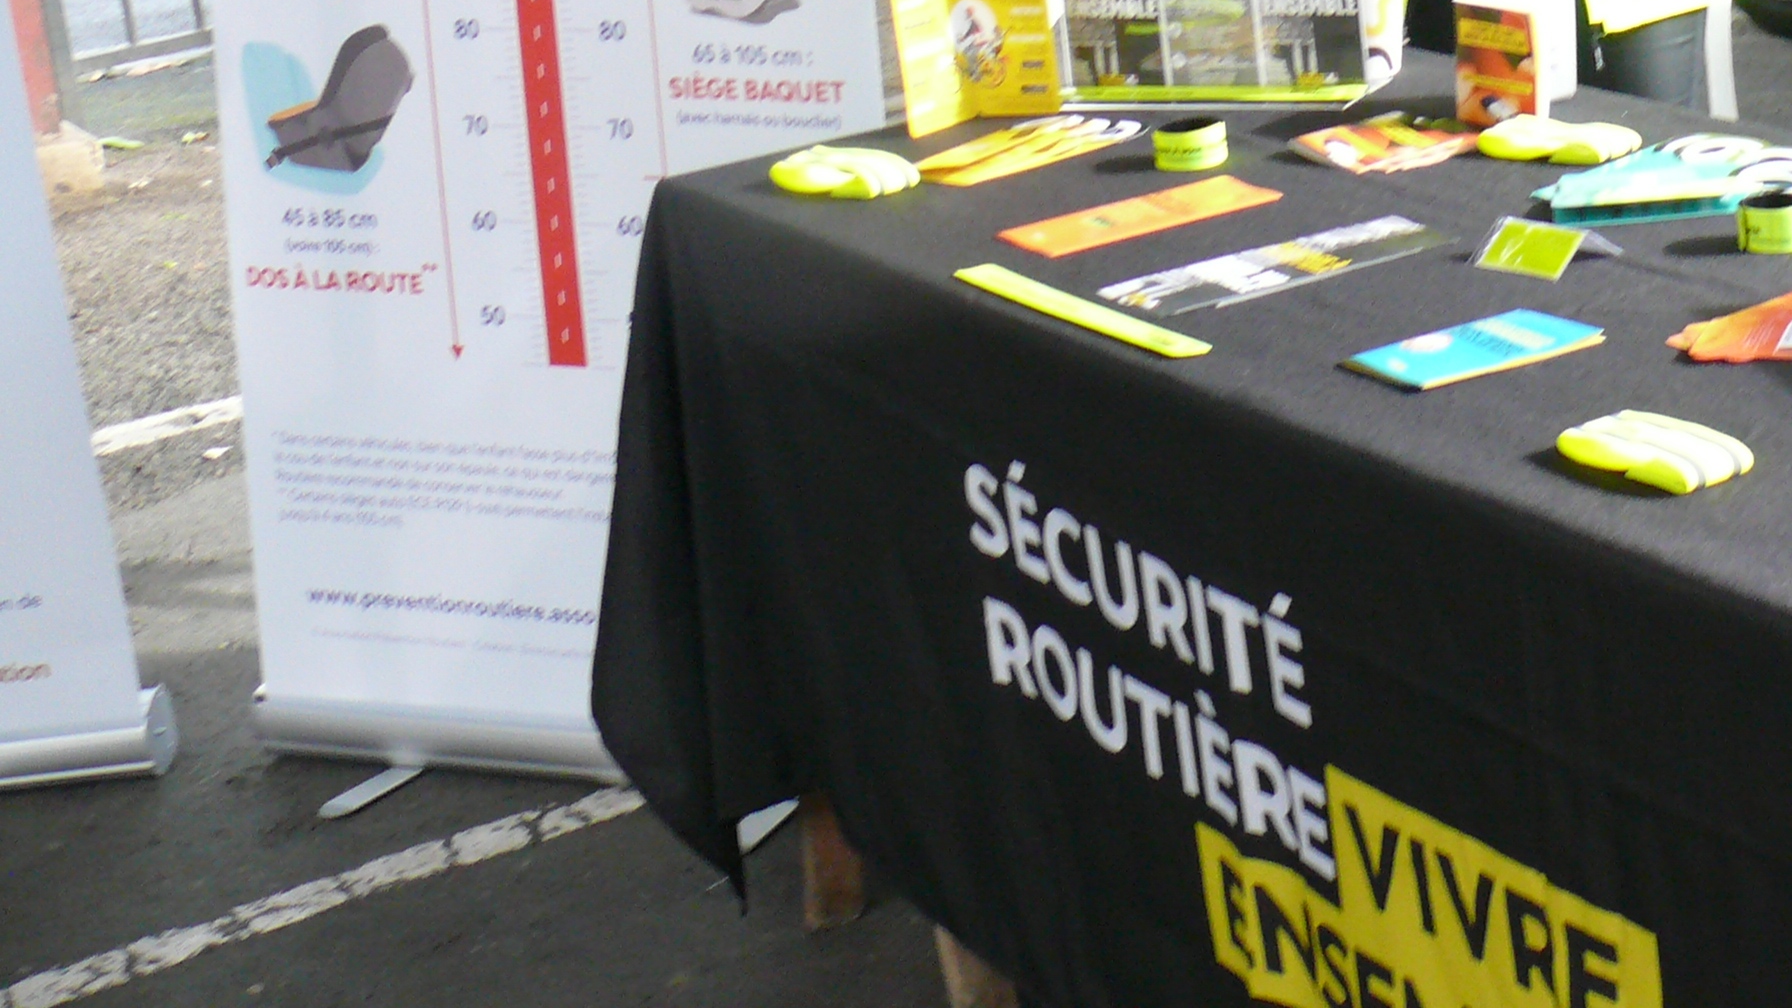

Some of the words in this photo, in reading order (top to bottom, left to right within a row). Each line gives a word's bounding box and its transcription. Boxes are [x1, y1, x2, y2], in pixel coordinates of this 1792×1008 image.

[454, 19, 480, 40] 80
[598, 20, 626, 41] 80
[668, 71, 738, 100] SIÈGE
[744, 79, 846, 103] BAQUET
[462, 115, 488, 135] 70
[607, 119, 634, 140] 70
[472, 210, 497, 232] 60
[617, 215, 643, 237] 60
[246, 266, 290, 289] DOS
[313, 269, 340, 291] LA
[480, 305, 506, 325] 50
[964, 460, 1313, 729] SÉCURITÉ
[982, 596, 1336, 882] ROUTIÈRE
[1342, 800, 1619, 1008] VIVRE
[1220, 856, 1470, 1008] ENSE
